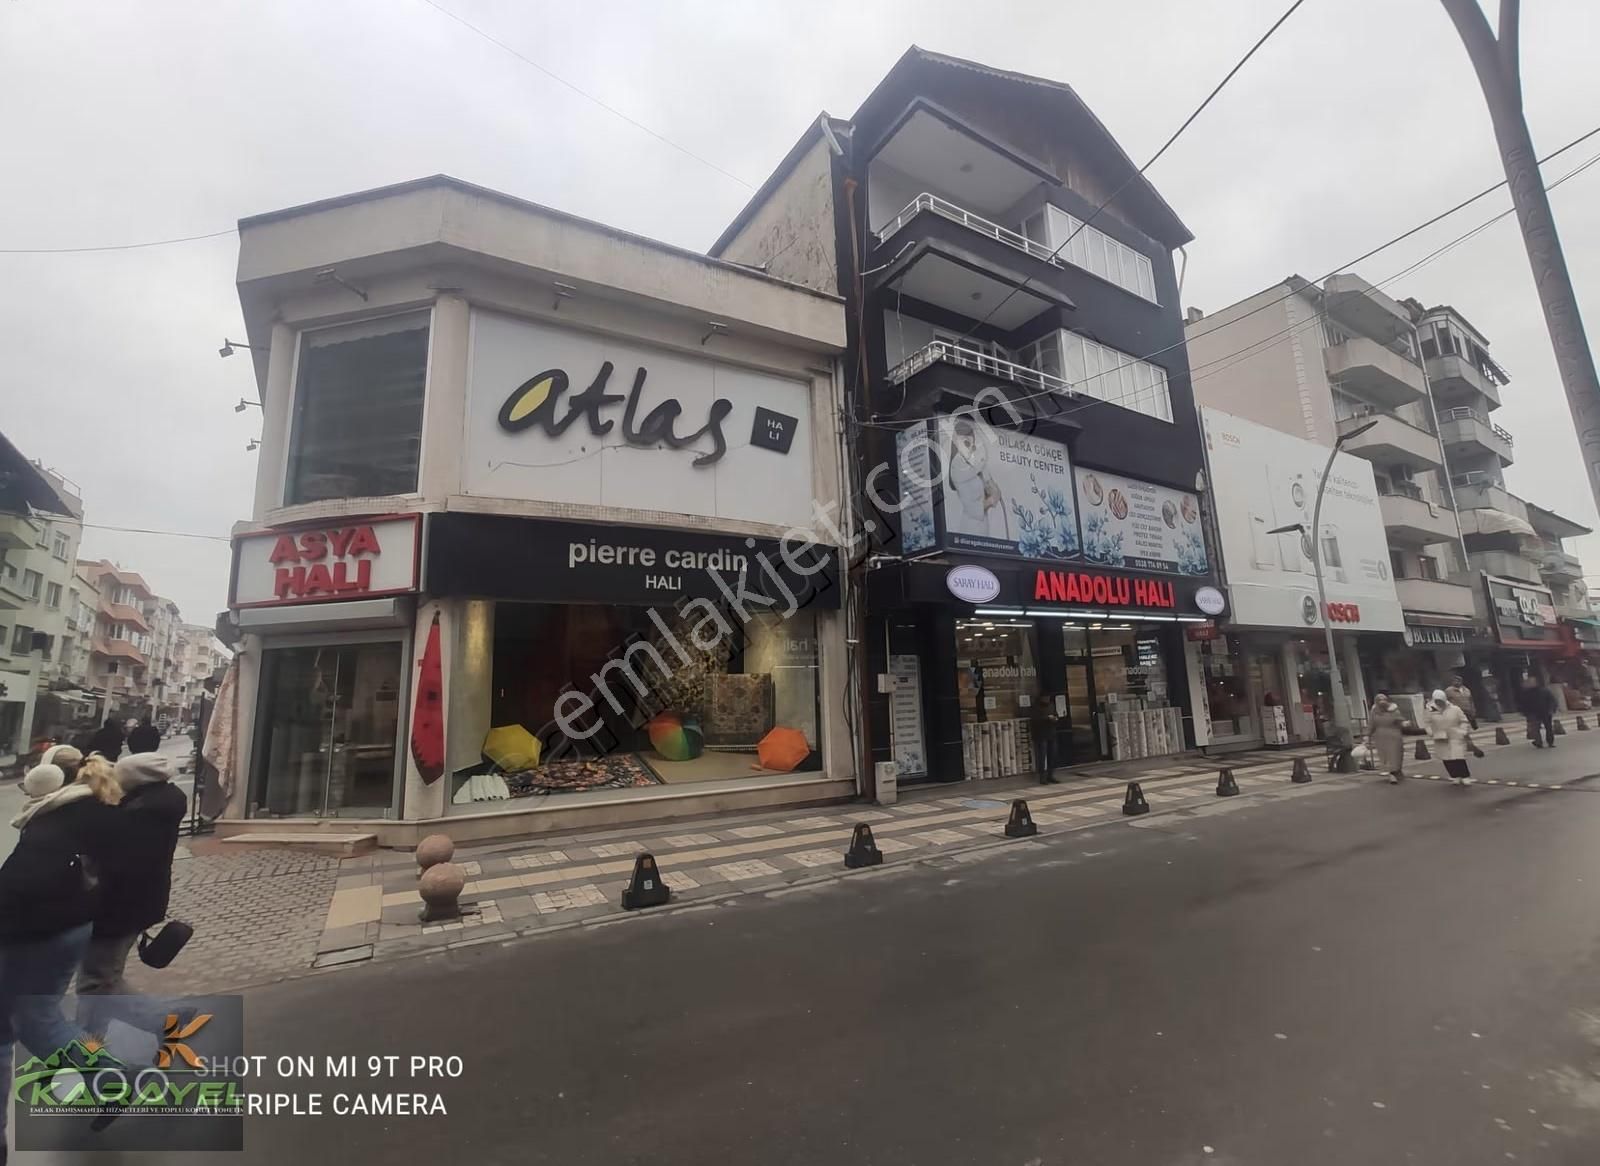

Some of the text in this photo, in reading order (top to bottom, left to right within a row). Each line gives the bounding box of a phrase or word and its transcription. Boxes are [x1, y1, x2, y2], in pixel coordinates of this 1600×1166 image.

[498, 361, 733, 468] atlas
[767, 418, 784, 431] HA
[769, 430, 780, 441] LI
[999, 451, 1065, 475] BEAUTY CENTER
[268, 526, 381, 564] ASYA
[568, 538, 748, 572] pierre cardin
[272, 559, 371, 599] HALI
[645, 575, 682, 591] HALI
[953, 576, 976, 589] SARAY
[1035, 569, 1175, 608] ANADOLU HALI
[1321, 602, 1360, 623] OSCH
[982, 664, 1019, 678] anadolu
